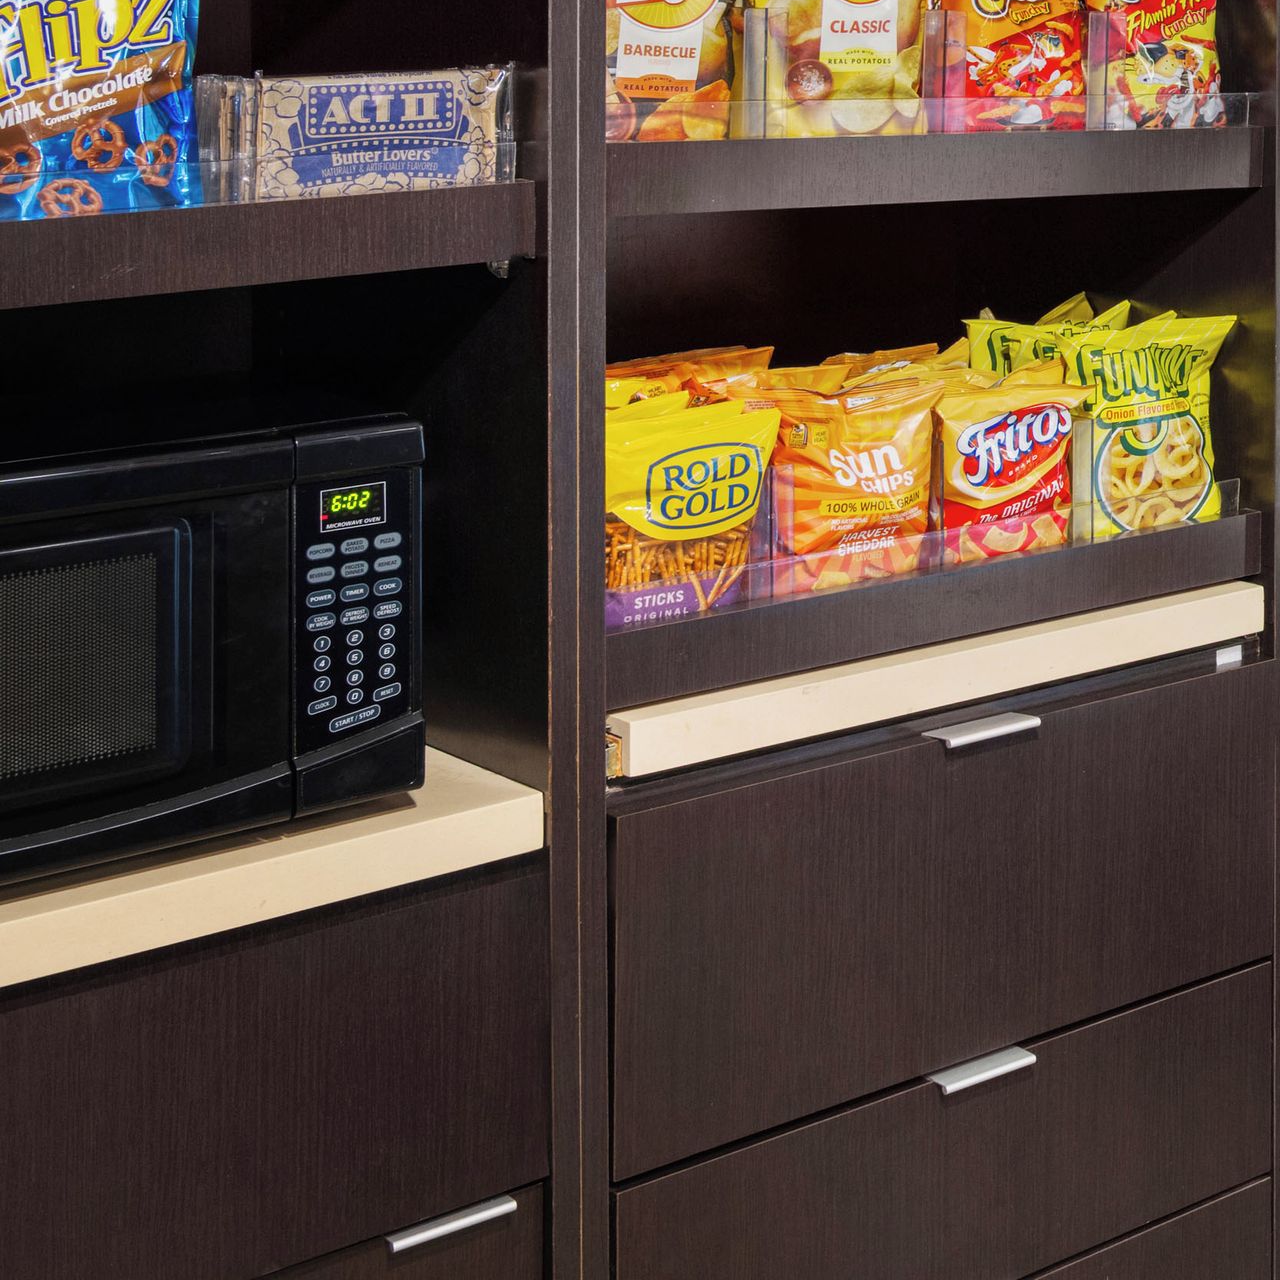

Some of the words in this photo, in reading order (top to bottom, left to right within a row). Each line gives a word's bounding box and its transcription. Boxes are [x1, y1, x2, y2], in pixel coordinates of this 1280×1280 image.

[1010, 3, 1050, 24] Crunchy
[1160, 8, 1207, 39] Crunchy
[830, 20, 891, 35] CLASSIC
[623, 43, 697, 59] BARBECUE
[851, 57, 892, 65] POTATOES
[49, 65, 153, 112] Chocolate
[624, 84, 645, 92] REAL
[648, 84, 689, 93] POTATOES
[46, 109, 80, 126] Covered
[81, 98, 117, 116] Pretzels
[322, 94, 394, 125] ACT
[400, 92, 440, 120] II
[332, 150, 381, 167] Butter
[384, 147, 431, 162] Lovers
[322, 164, 357, 178] NATURALLY
[366, 162, 405, 172] ARTIFICIALLY
[407, 161, 438, 171] FLAVORED
[1105, 408, 1134, 419] Onion
[1138, 403, 1175, 417] Flavored
[957, 406, 1072, 487] Fritos
[662, 453, 751, 491] ROLD
[829, 443, 903, 488] Sun
[1008, 454, 1038, 476] BRAND
[860, 470, 914, 494] CHIPS
[331, 491, 370, 512] 6:02
[660, 483, 750, 521] GOLD
[826, 502, 858, 514] 100%
[860, 499, 895, 513] WHOLE
[896, 491, 920, 510] GRAIN
[326, 519, 362, 529] MICROWAVE
[980, 513, 998, 524] The
[841, 526, 900, 544] HARVEST
[838, 537, 895, 556] CHEDDAR
[310, 594, 332, 602] POWER
[346, 588, 364, 596] TIMER
[634, 590, 685, 610] STICKS
[624, 607, 689, 624] ORIGINAL
[335, 716, 354, 728] START
[359, 710, 375, 720] STOP
